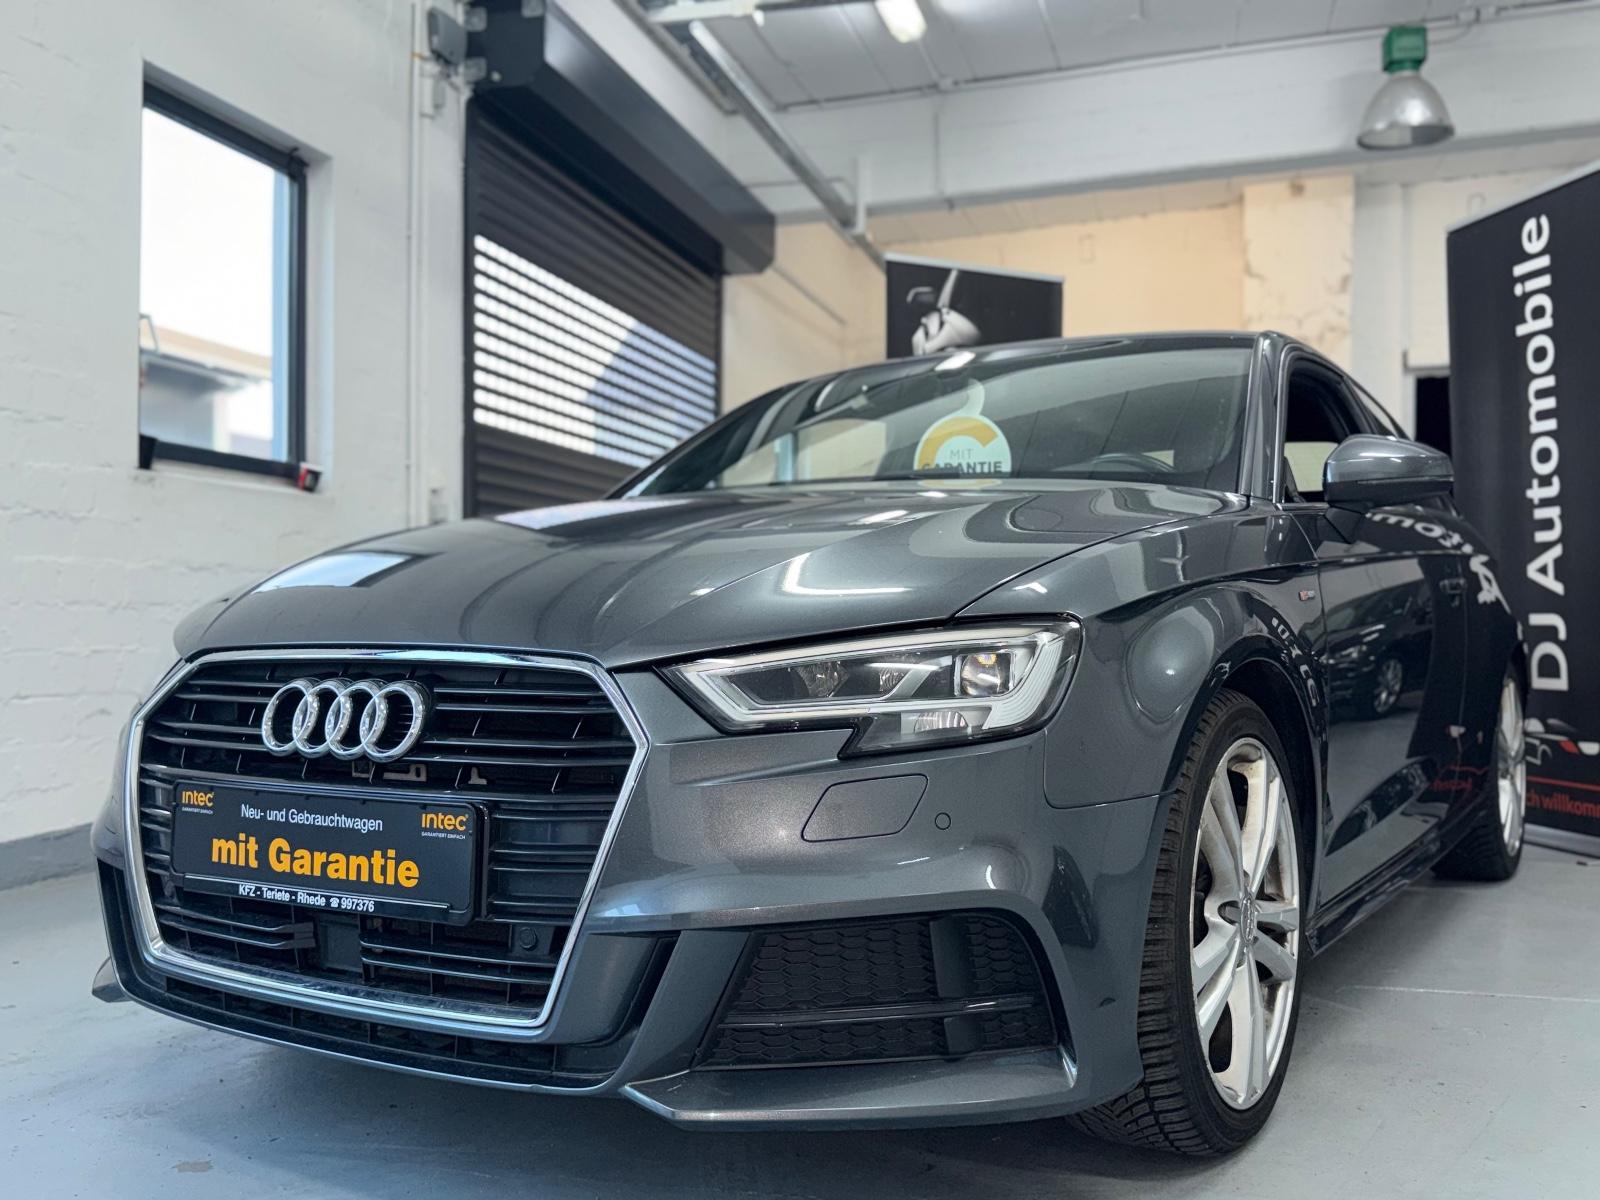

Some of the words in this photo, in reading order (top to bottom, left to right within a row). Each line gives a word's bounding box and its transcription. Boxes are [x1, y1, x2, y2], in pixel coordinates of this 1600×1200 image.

[1513, 214, 1565, 596] Automobile
[950, 448, 974, 460] MIT
[1528, 613, 1569, 691] DJ
[182, 790, 213, 807] intec
[241, 804, 264, 819] Neu-
[266, 808, 286, 822] und
[288, 808, 383, 833] Gebrauchtwagen
[421, 812, 467, 831] intec
[211, 832, 258, 868] mit
[268, 837, 420, 888] Garantie
[239, 884, 256, 896] KFZ
[262, 887, 290, 901] Teriete
[297, 891, 326, 906] Rhede
[341, 897, 375, 912] 997376
